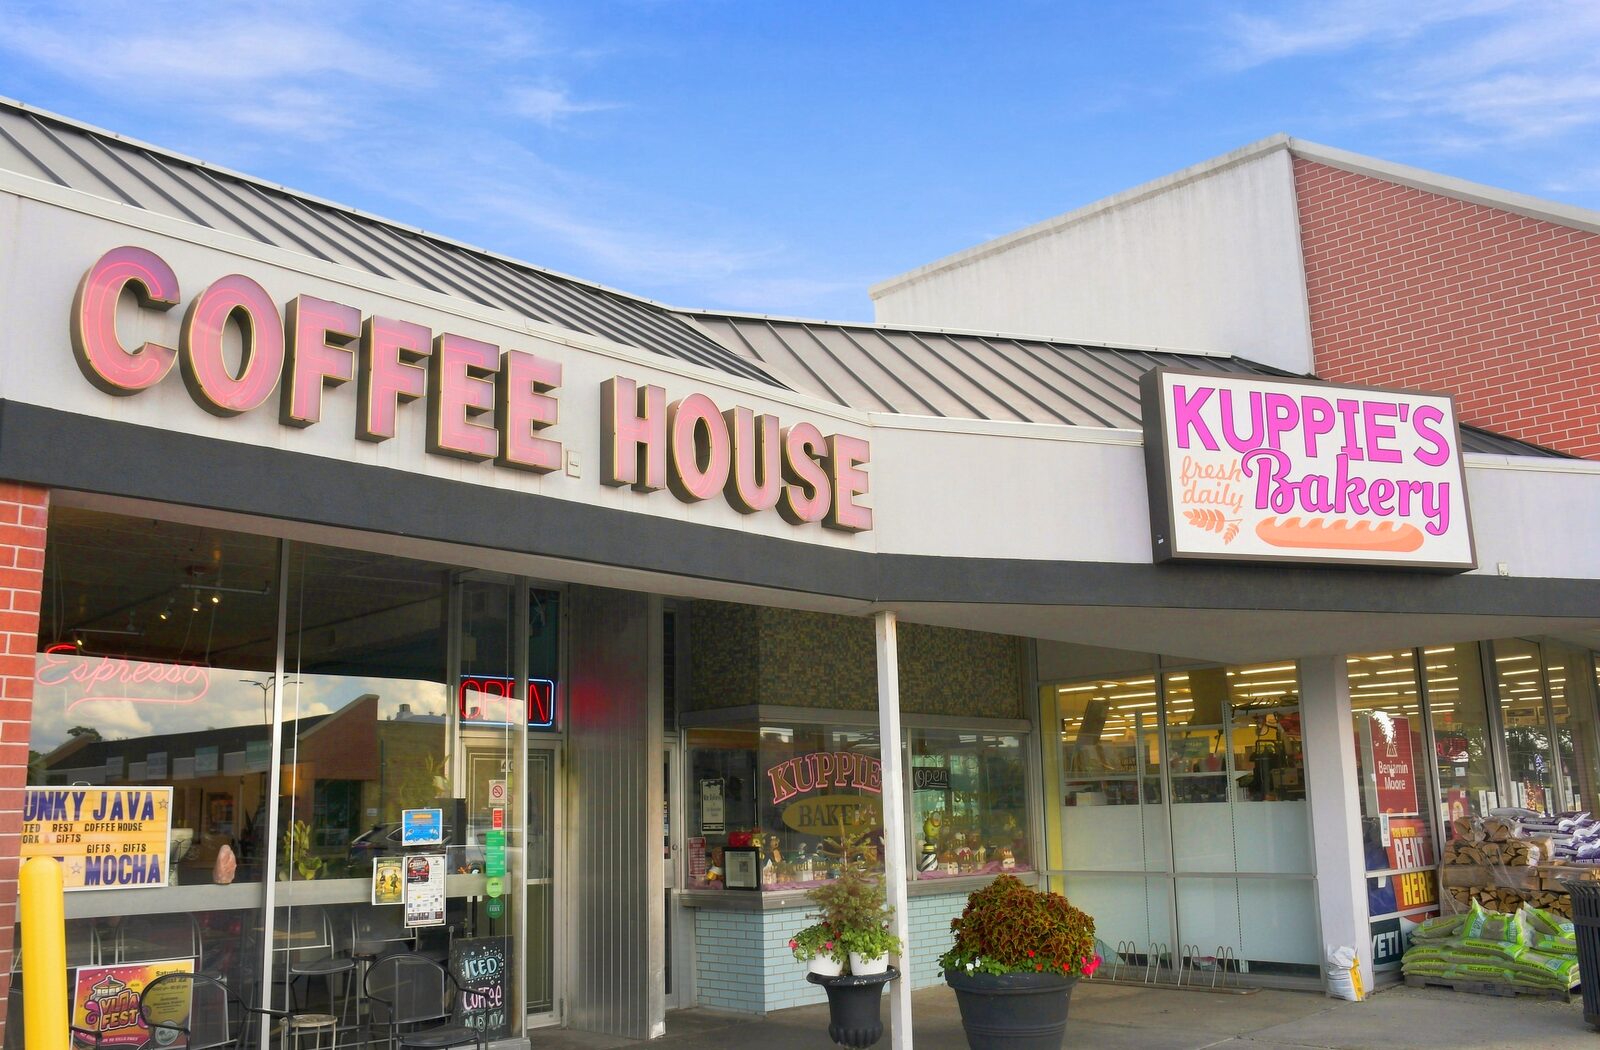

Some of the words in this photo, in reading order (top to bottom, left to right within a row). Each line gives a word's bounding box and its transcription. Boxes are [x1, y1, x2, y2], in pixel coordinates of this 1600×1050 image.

[70, 246, 562, 474] COFFEE
[600, 375, 873, 533] HOUSE
[1173, 385, 1450, 467] KUPPIE'S
[1179, 456, 1241, 483] fresh
[1181, 482, 1244, 514] daily
[1241, 448, 1450, 535] Bakery
[36, 643, 209, 694] Espresso
[1378, 760, 1409, 777] Benjamin
[1384, 777, 1406, 790] Moore
[93, 792, 154, 821] JAVA
[798, 803, 866, 827] BAKE
[52, 823, 74, 832] BEST
[84, 823, 116, 832] COFFEE
[117, 822, 143, 832] HOUSE
[56, 834, 81, 843] GIFTS
[123, 843, 147, 853] GIFTS
[1394, 837, 1425, 869] RENT
[84, 854, 161, 886] MOCHA
[1401, 870, 1434, 906] HERE
[464, 958, 497, 978] ICED
[101, 1009, 138, 1030] FEST
